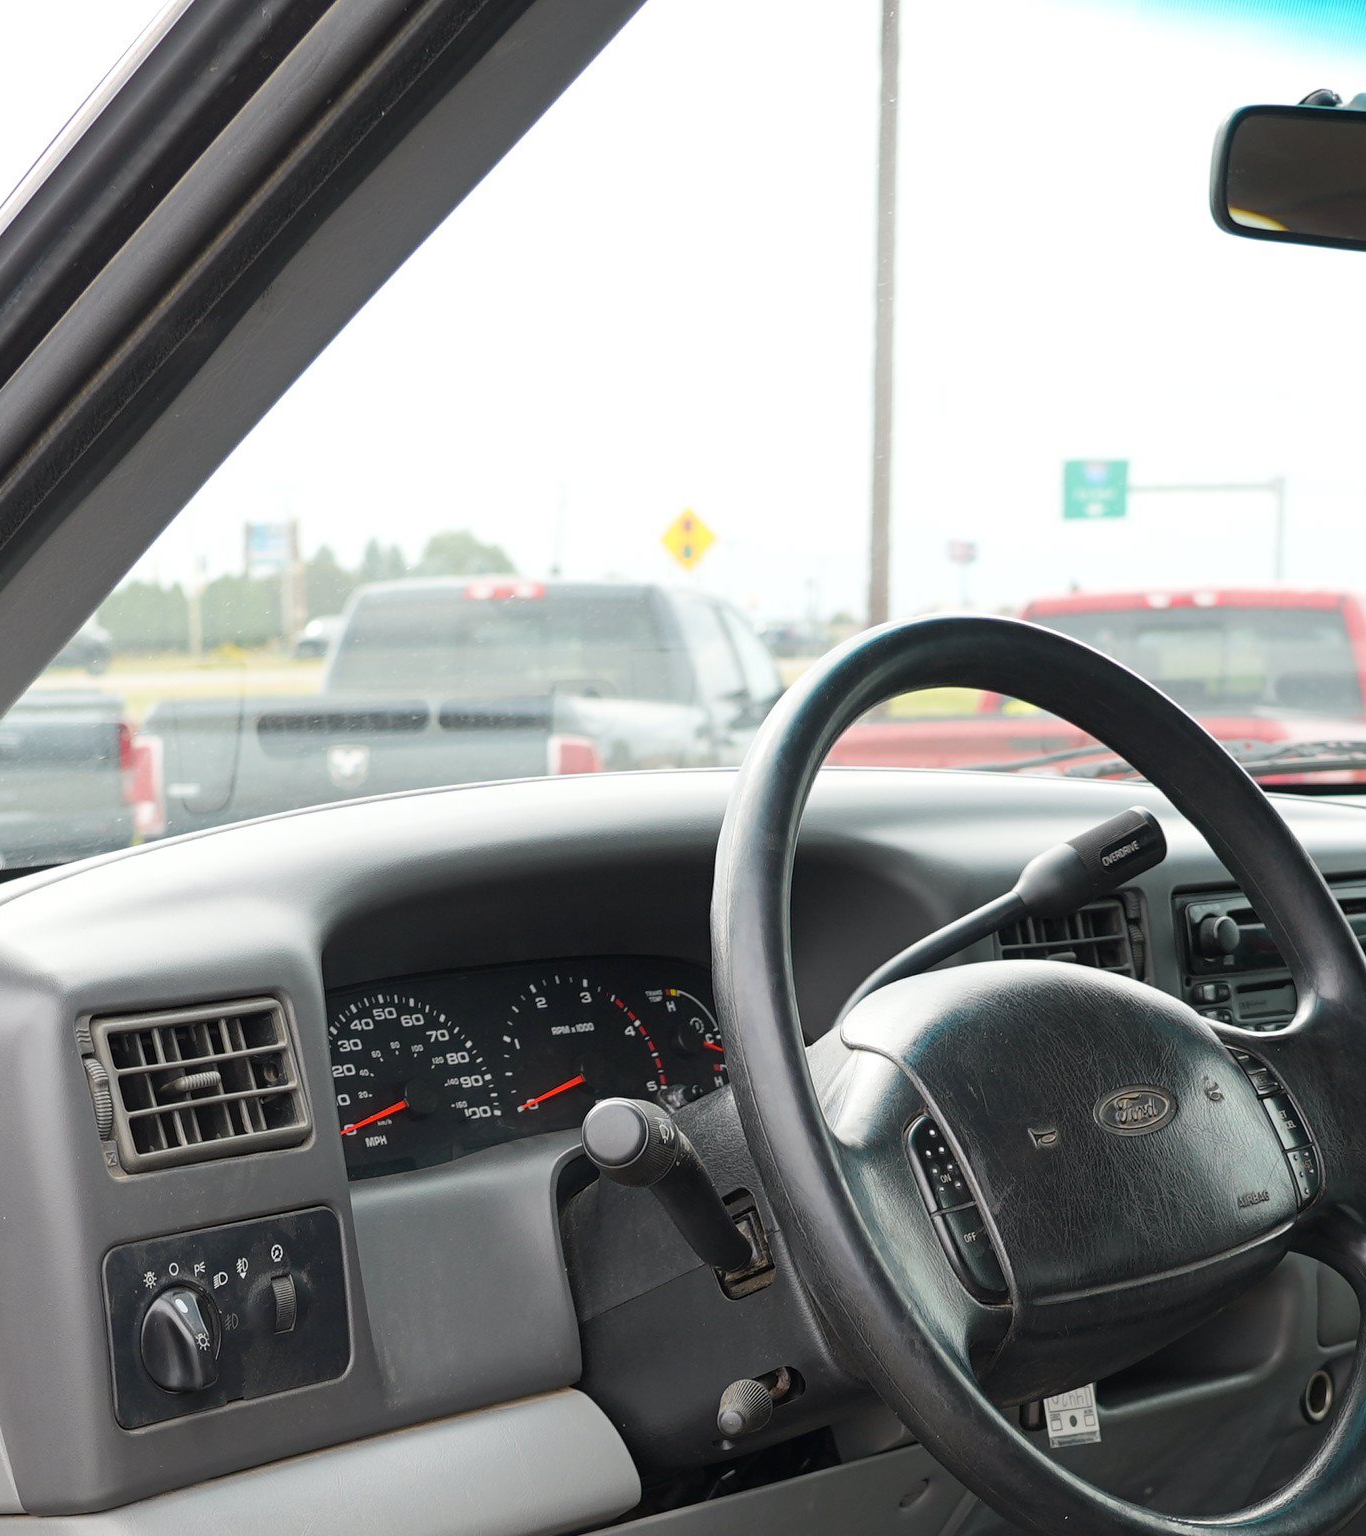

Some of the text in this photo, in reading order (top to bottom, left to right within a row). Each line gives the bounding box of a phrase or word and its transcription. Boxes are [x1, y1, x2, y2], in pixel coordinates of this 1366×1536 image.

[1101, 840, 1140, 867] OVERDRIVE
[535, 997, 548, 1009] 2
[580, 992, 592, 1003] 3
[665, 1000, 677, 1012] H
[372, 1007, 397, 1021] 50
[400, 1014, 424, 1027] 60
[350, 1018, 374, 1031] 40
[425, 1029, 450, 1043] 70
[624, 1027, 636, 1037] 4
[337, 1038, 362, 1053] 30
[390, 1041, 400, 1049] 80
[411, 1044, 424, 1052] 100
[432, 1056, 445, 1064] 120
[445, 1051, 470, 1065] 80
[332, 1064, 356, 1078] 20
[459, 1074, 483, 1088] 90
[714, 1075, 724, 1088] H
[337, 1094, 351, 1107] 0
[358, 1091, 368, 1099] 20
[464, 1105, 491, 1119] 100
[1115, 1093, 1158, 1124] Ford
[377, 1118, 392, 1126] km/h
[365, 1135, 388, 1148] MPH
[940, 1174, 952, 1184] ON
[1238, 1190, 1271, 1208] AIRBAG
[963, 1231, 977, 1244] OFF
